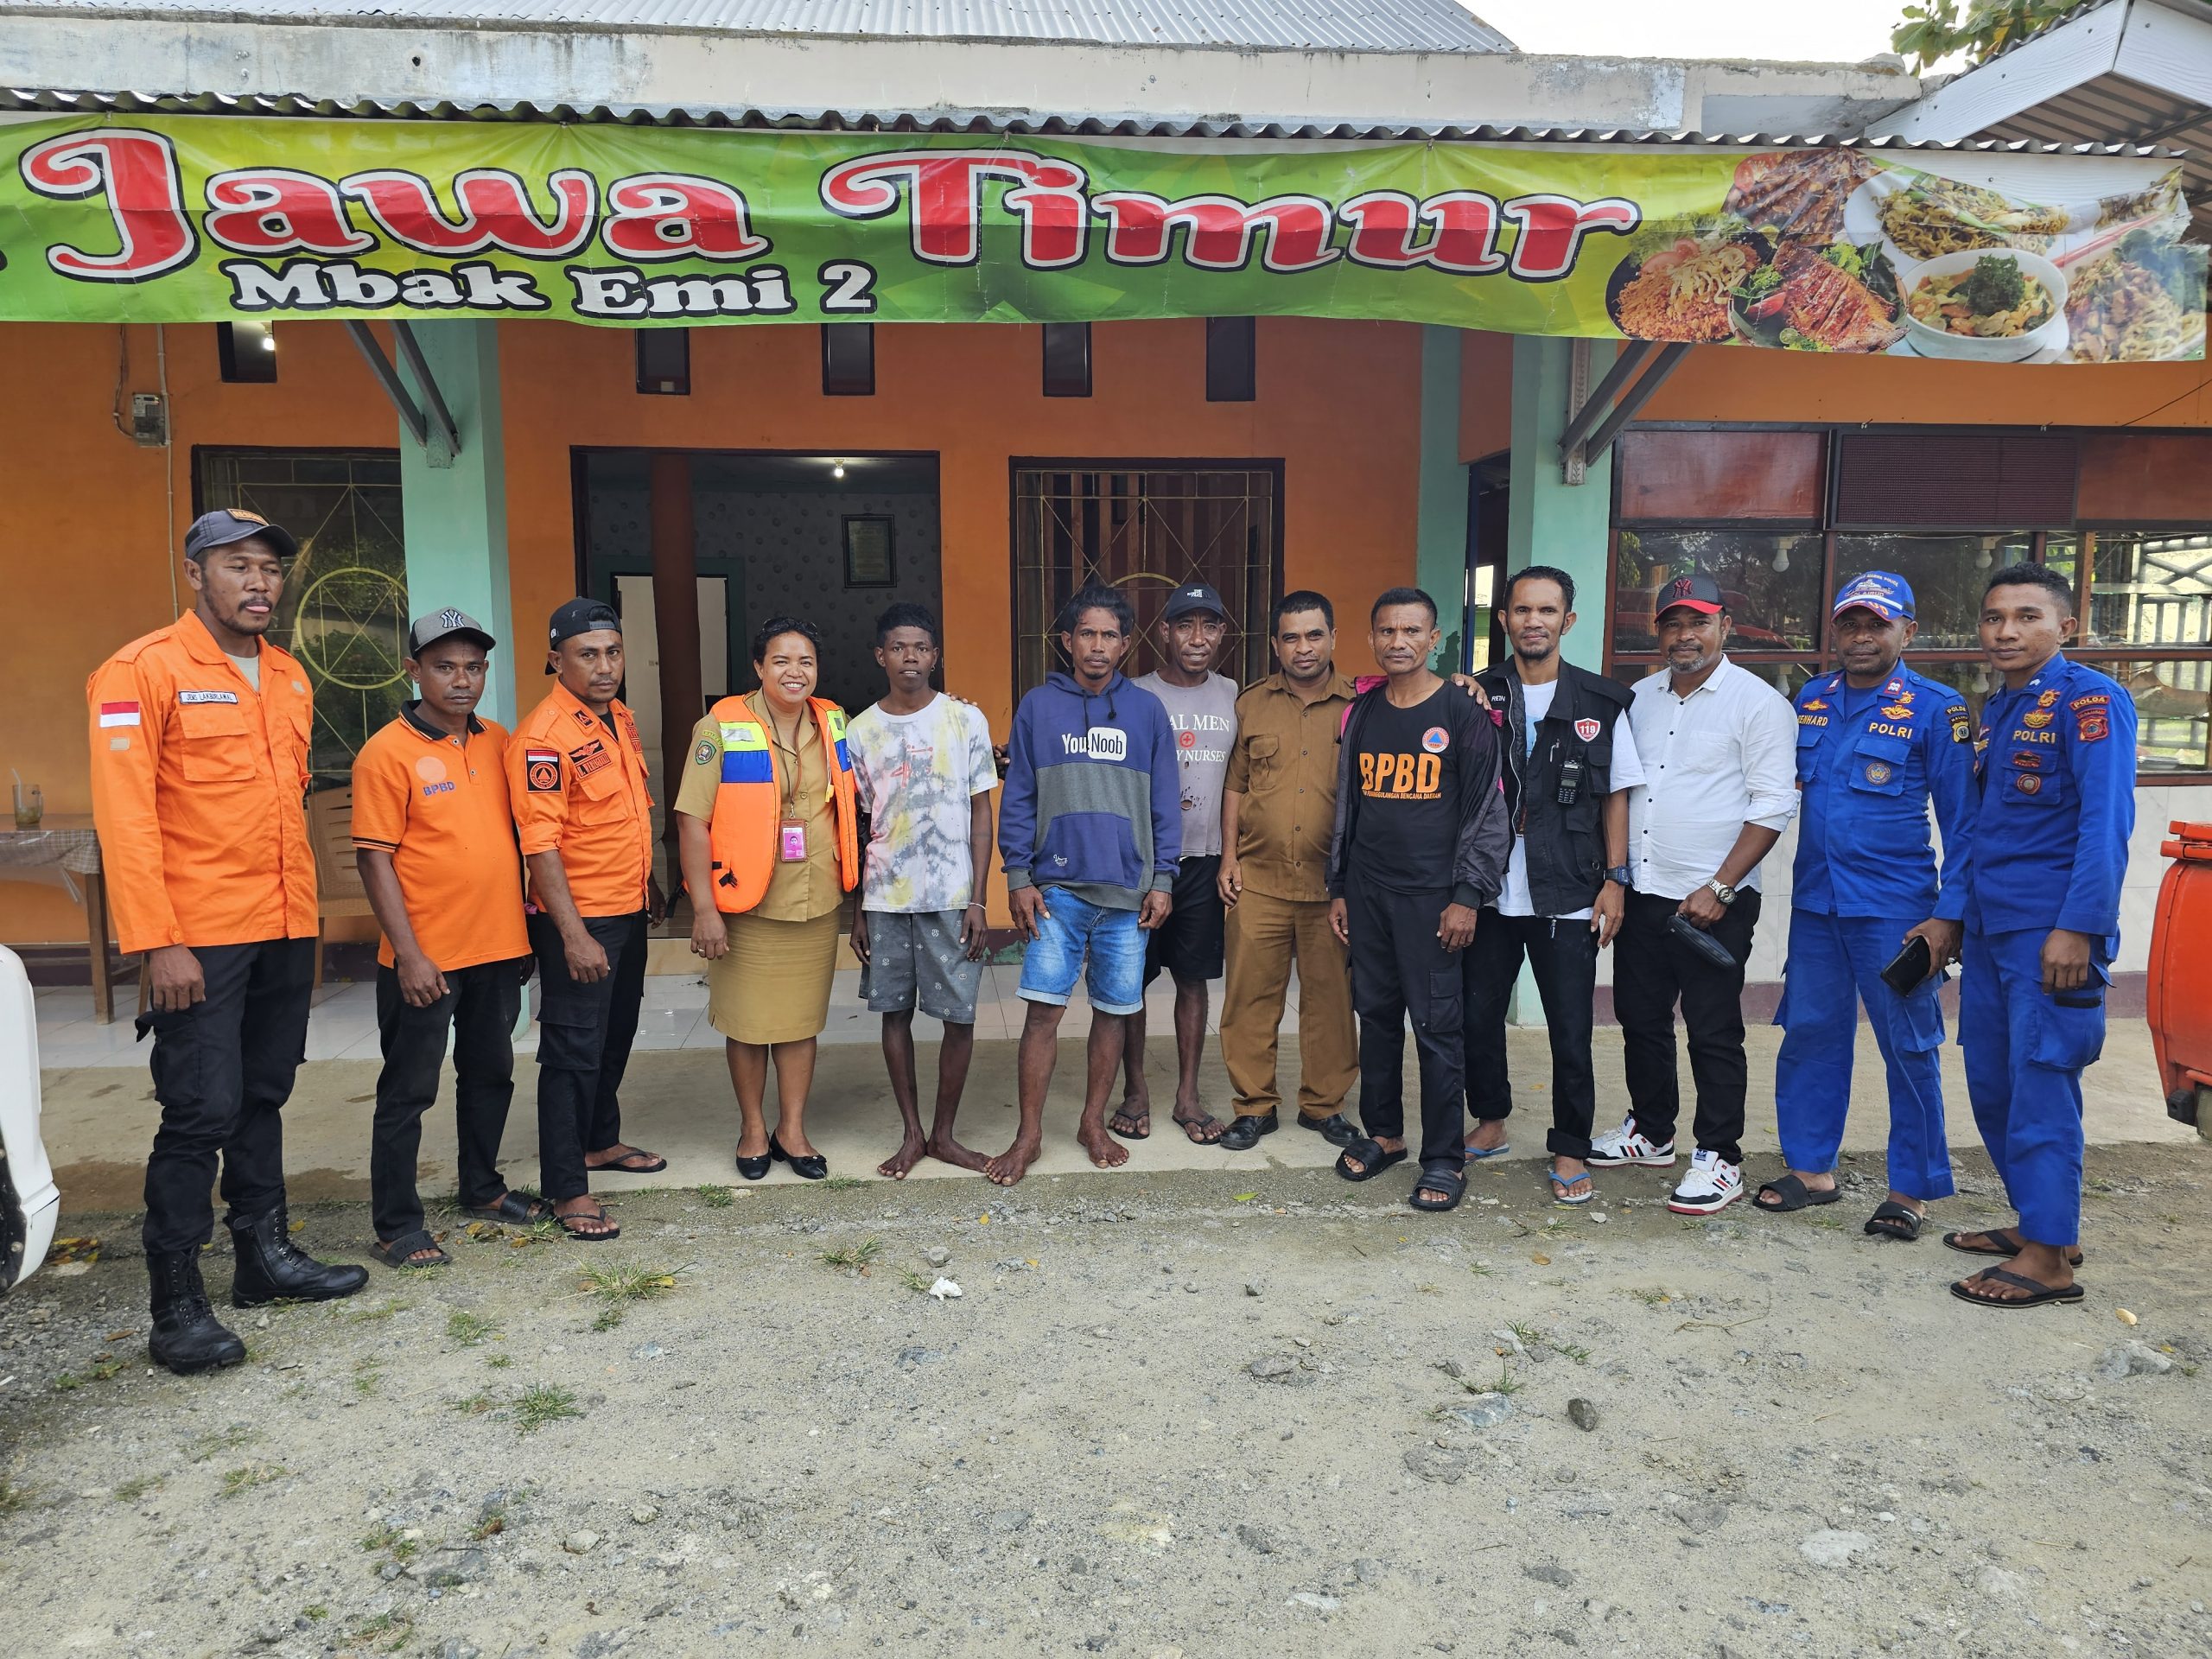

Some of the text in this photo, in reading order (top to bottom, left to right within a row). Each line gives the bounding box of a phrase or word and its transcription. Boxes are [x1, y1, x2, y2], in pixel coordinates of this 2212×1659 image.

[19, 128, 1642, 283] Jawa Timur
[219, 259, 877, 320] Mbak Emi 2
[1192, 714, 1230, 733] MEN
[1580, 725, 1596, 734] 119
[1868, 722, 1913, 740] POLRI
[2012, 730, 2056, 744] POLRI
[1185, 750, 1226, 762] NURSES
[1359, 753, 1441, 793] BPBD
[423, 781, 455, 796] BPBD
